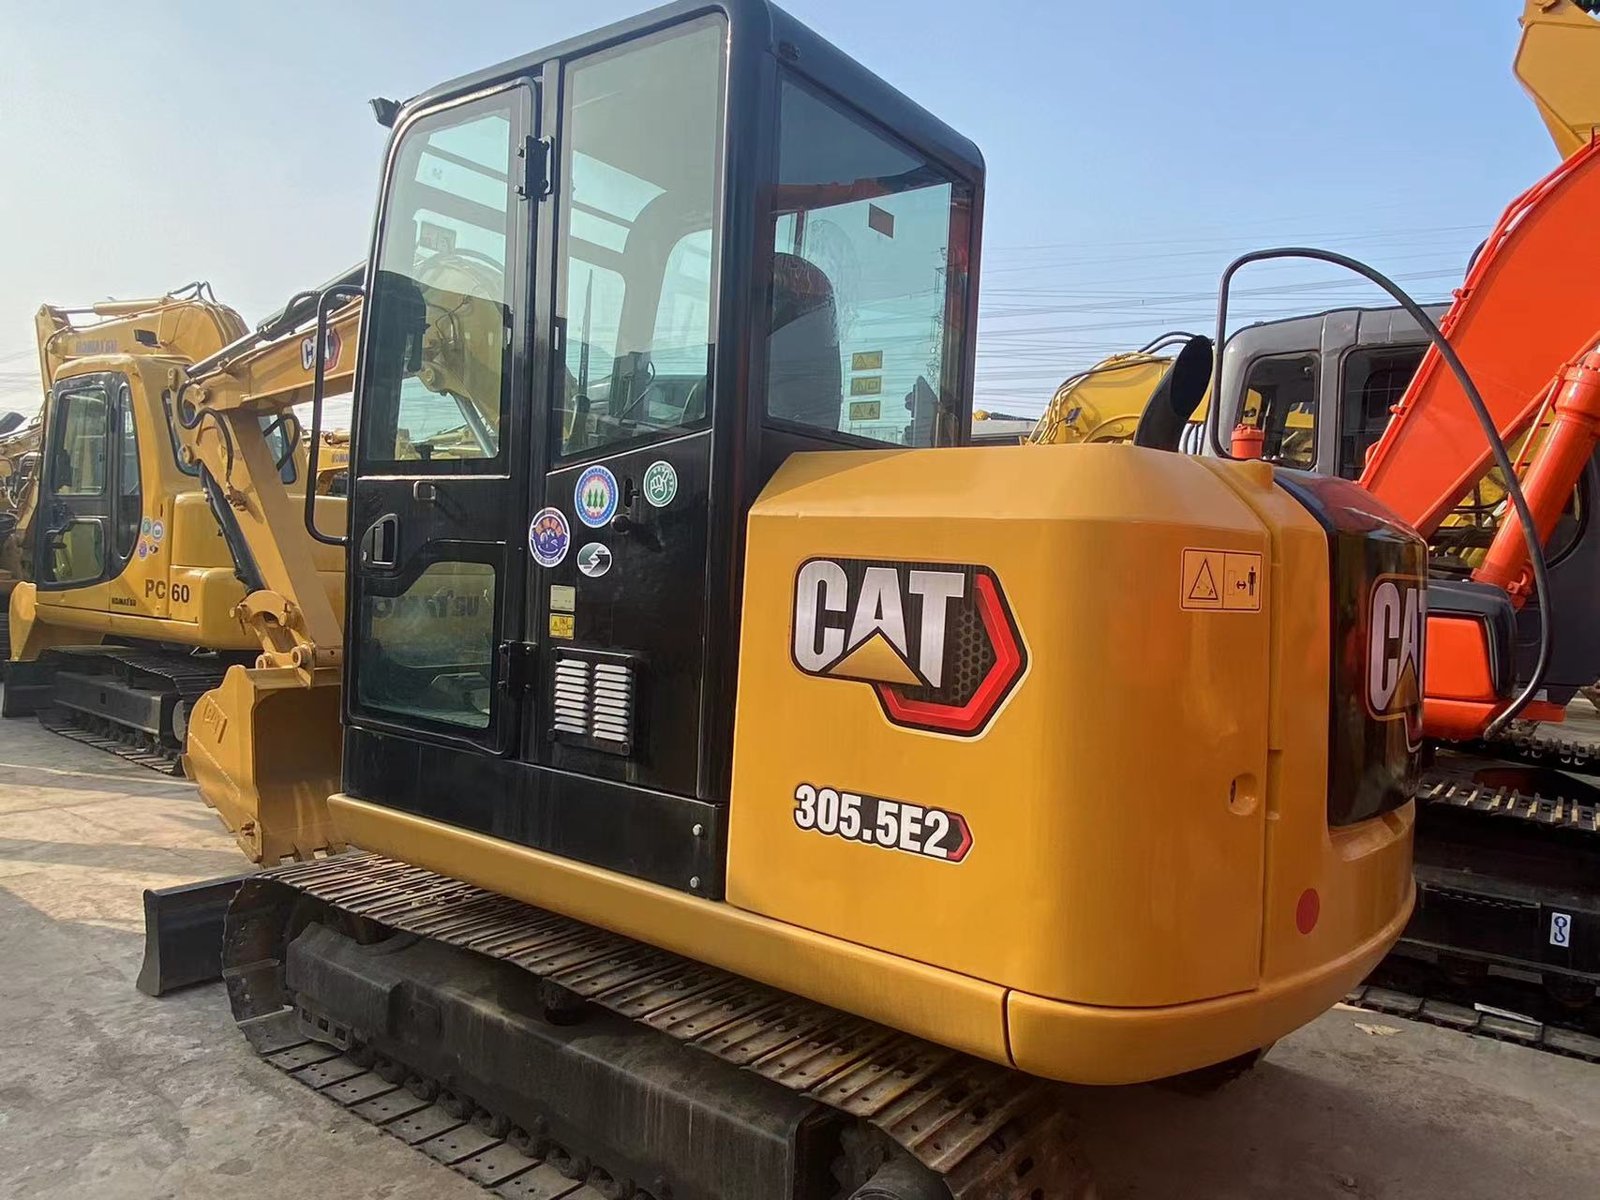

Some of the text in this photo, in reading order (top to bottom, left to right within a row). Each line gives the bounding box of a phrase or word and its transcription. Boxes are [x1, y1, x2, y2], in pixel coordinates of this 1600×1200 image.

[145, 579, 190, 603] PC 60
[794, 560, 965, 688] CAT
[794, 784, 950, 858] 305.5E2
